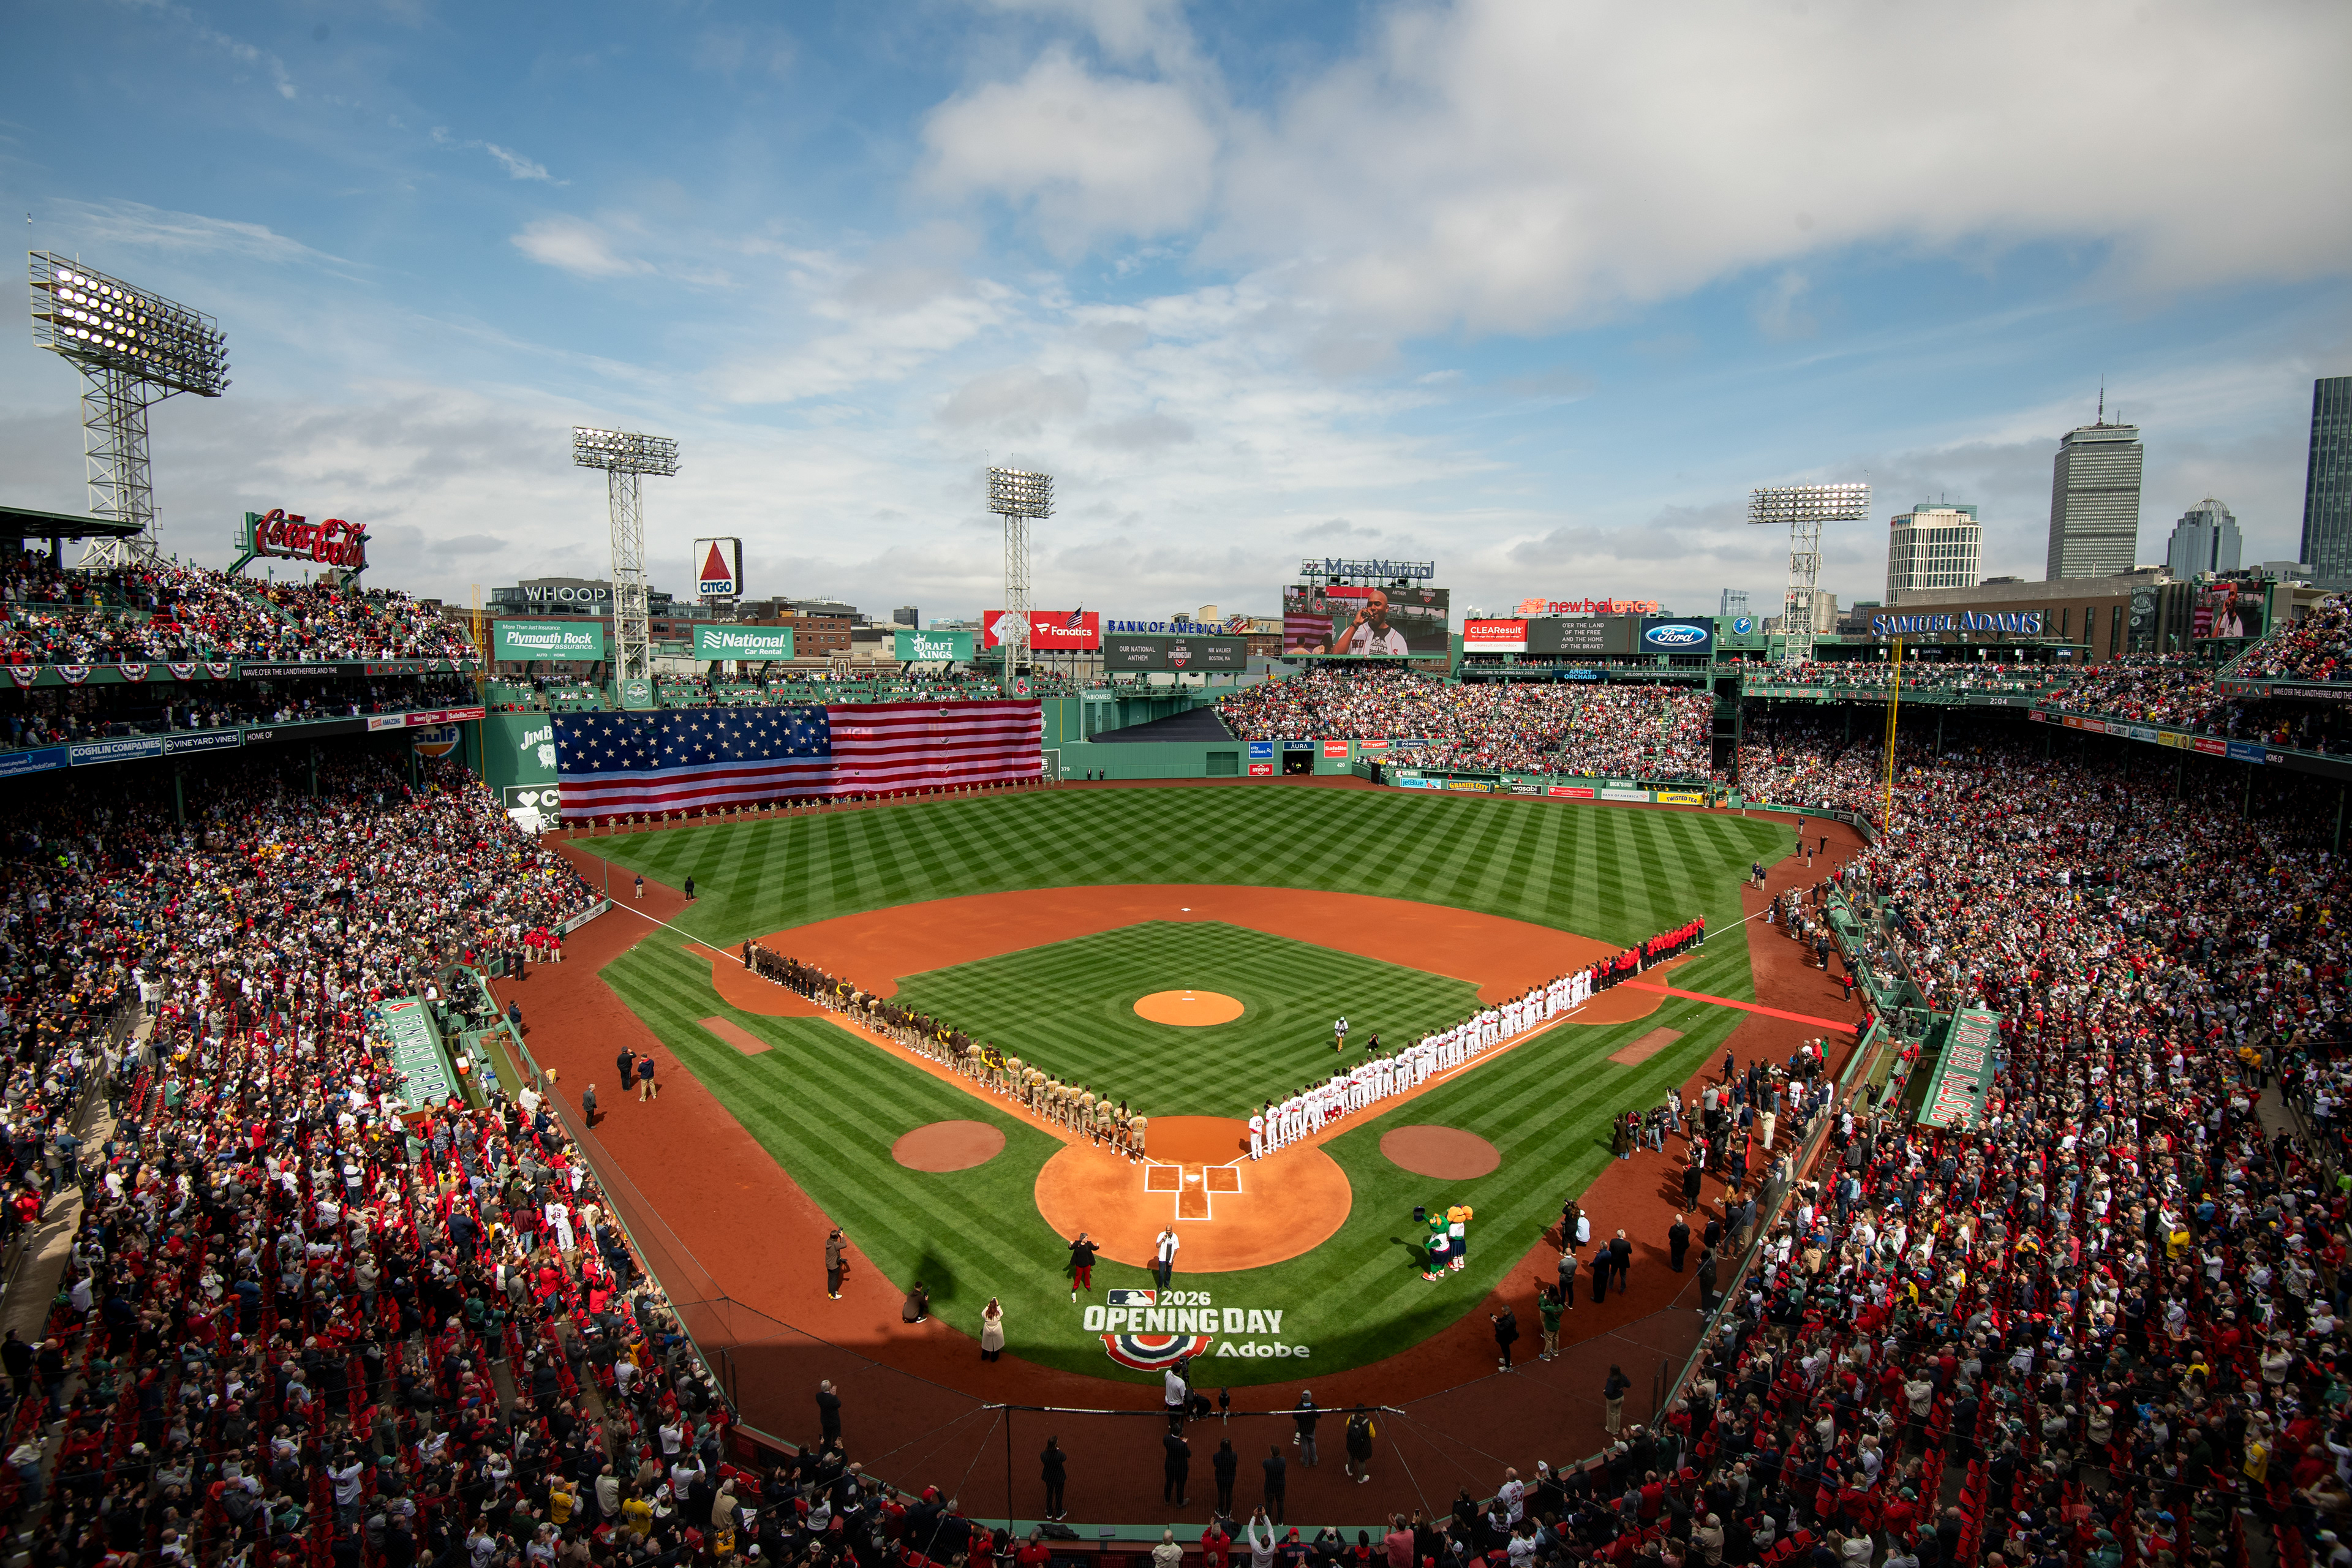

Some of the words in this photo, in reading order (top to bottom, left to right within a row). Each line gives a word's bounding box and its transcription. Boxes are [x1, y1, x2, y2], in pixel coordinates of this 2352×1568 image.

[257, 509, 366, 567] Coca-Cola
[1325, 557, 1434, 579] MassMutual
[525, 587, 606, 602] WHOOP
[700, 581, 732, 593] CITGO
[2132, 586, 2156, 595] BOSTON
[2130, 605, 2154, 614] ACADEMY
[1108, 620, 1145, 632] BANK
[1149, 622, 1165, 633] OF
[1169, 622, 1223, 634] AMERICA
[1872, 614, 1956, 636] SAMUEL
[1958, 610, 2041, 634] ADAMS
[507, 631, 561, 645] Plymouth
[564, 632, 592, 644] Rock
[1051, 626, 1092, 636] Fanatics
[1657, 627, 1694, 643] Ford
[722, 633, 785, 647] National
[913, 641, 954, 652] DRAFT
[919, 650, 953, 659] KINGS
[174, 737, 214, 748] VINEYARD
[214, 735, 237, 744] VINES
[247, 732, 264, 741] HOME
[413, 728, 455, 743] Gulf
[72, 744, 111, 757] COGHLIN
[111, 739, 160, 752] COMPANIES
[2266, 753, 2277, 763] HOME
[391, 1013, 437, 1065] FENWAY
[1956, 1022, 1992, 1048] SOX
[1948, 1046, 1986, 1072] RED
[407, 1063, 450, 1106] PARK
[1930, 1071, 1979, 1128] BOSTON
[1161, 1291, 1212, 1306] 2026
[485, 1318, 492, 1327] 19
[1083, 1305, 1219, 1333] OPENING
[1223, 1308, 1283, 1334] DAY
[1215, 1341, 1310, 1358] Adobe
